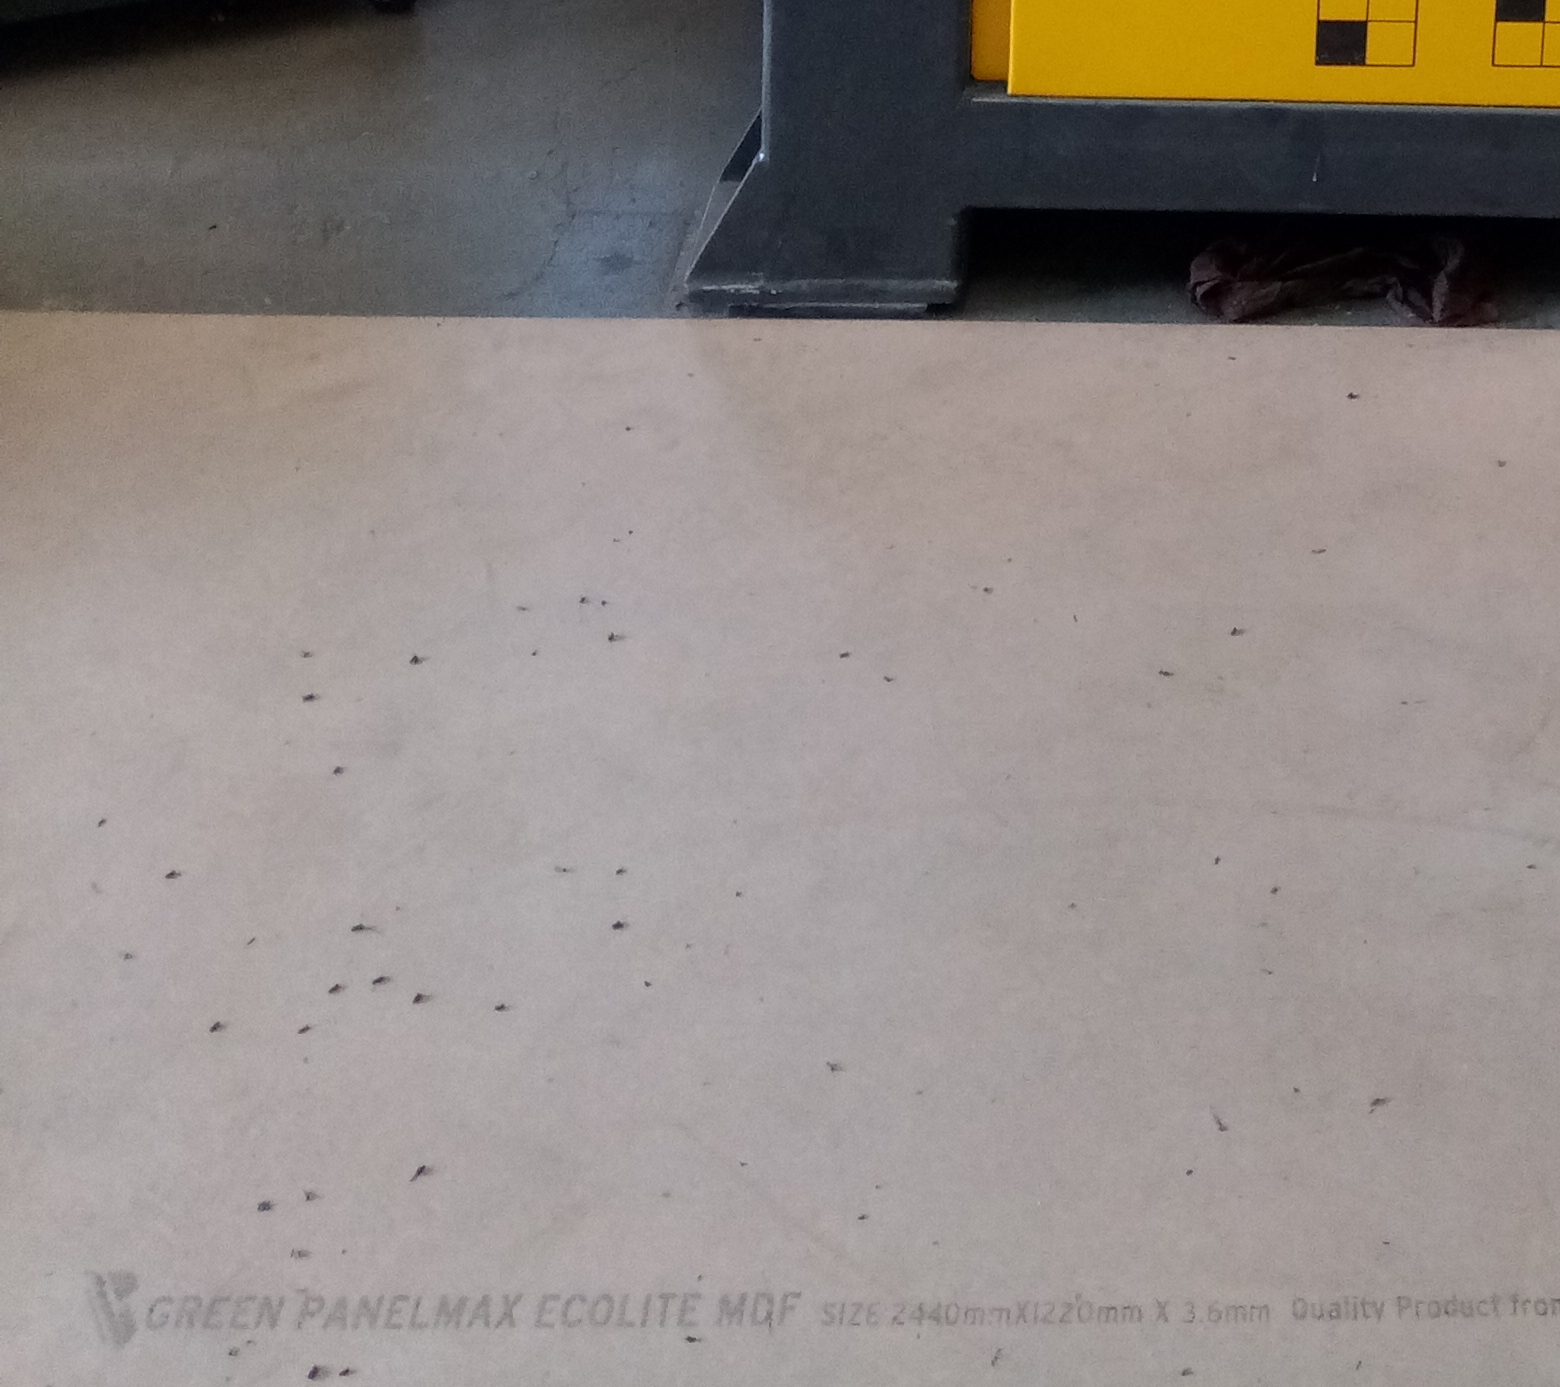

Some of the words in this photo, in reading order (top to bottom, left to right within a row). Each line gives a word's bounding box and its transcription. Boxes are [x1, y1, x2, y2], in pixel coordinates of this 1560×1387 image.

[144, 1294, 286, 1331] GREEN
[295, 1293, 524, 1333] PANELMAX
[534, 1291, 703, 1329] ECOLITE
[716, 1291, 802, 1329] MDF
[820, 1300, 882, 1327] SIZE
[1154, 1298, 1170, 1325] X
[1291, 1294, 1386, 1323] Quality
[1396, 1293, 1501, 1320] Product
